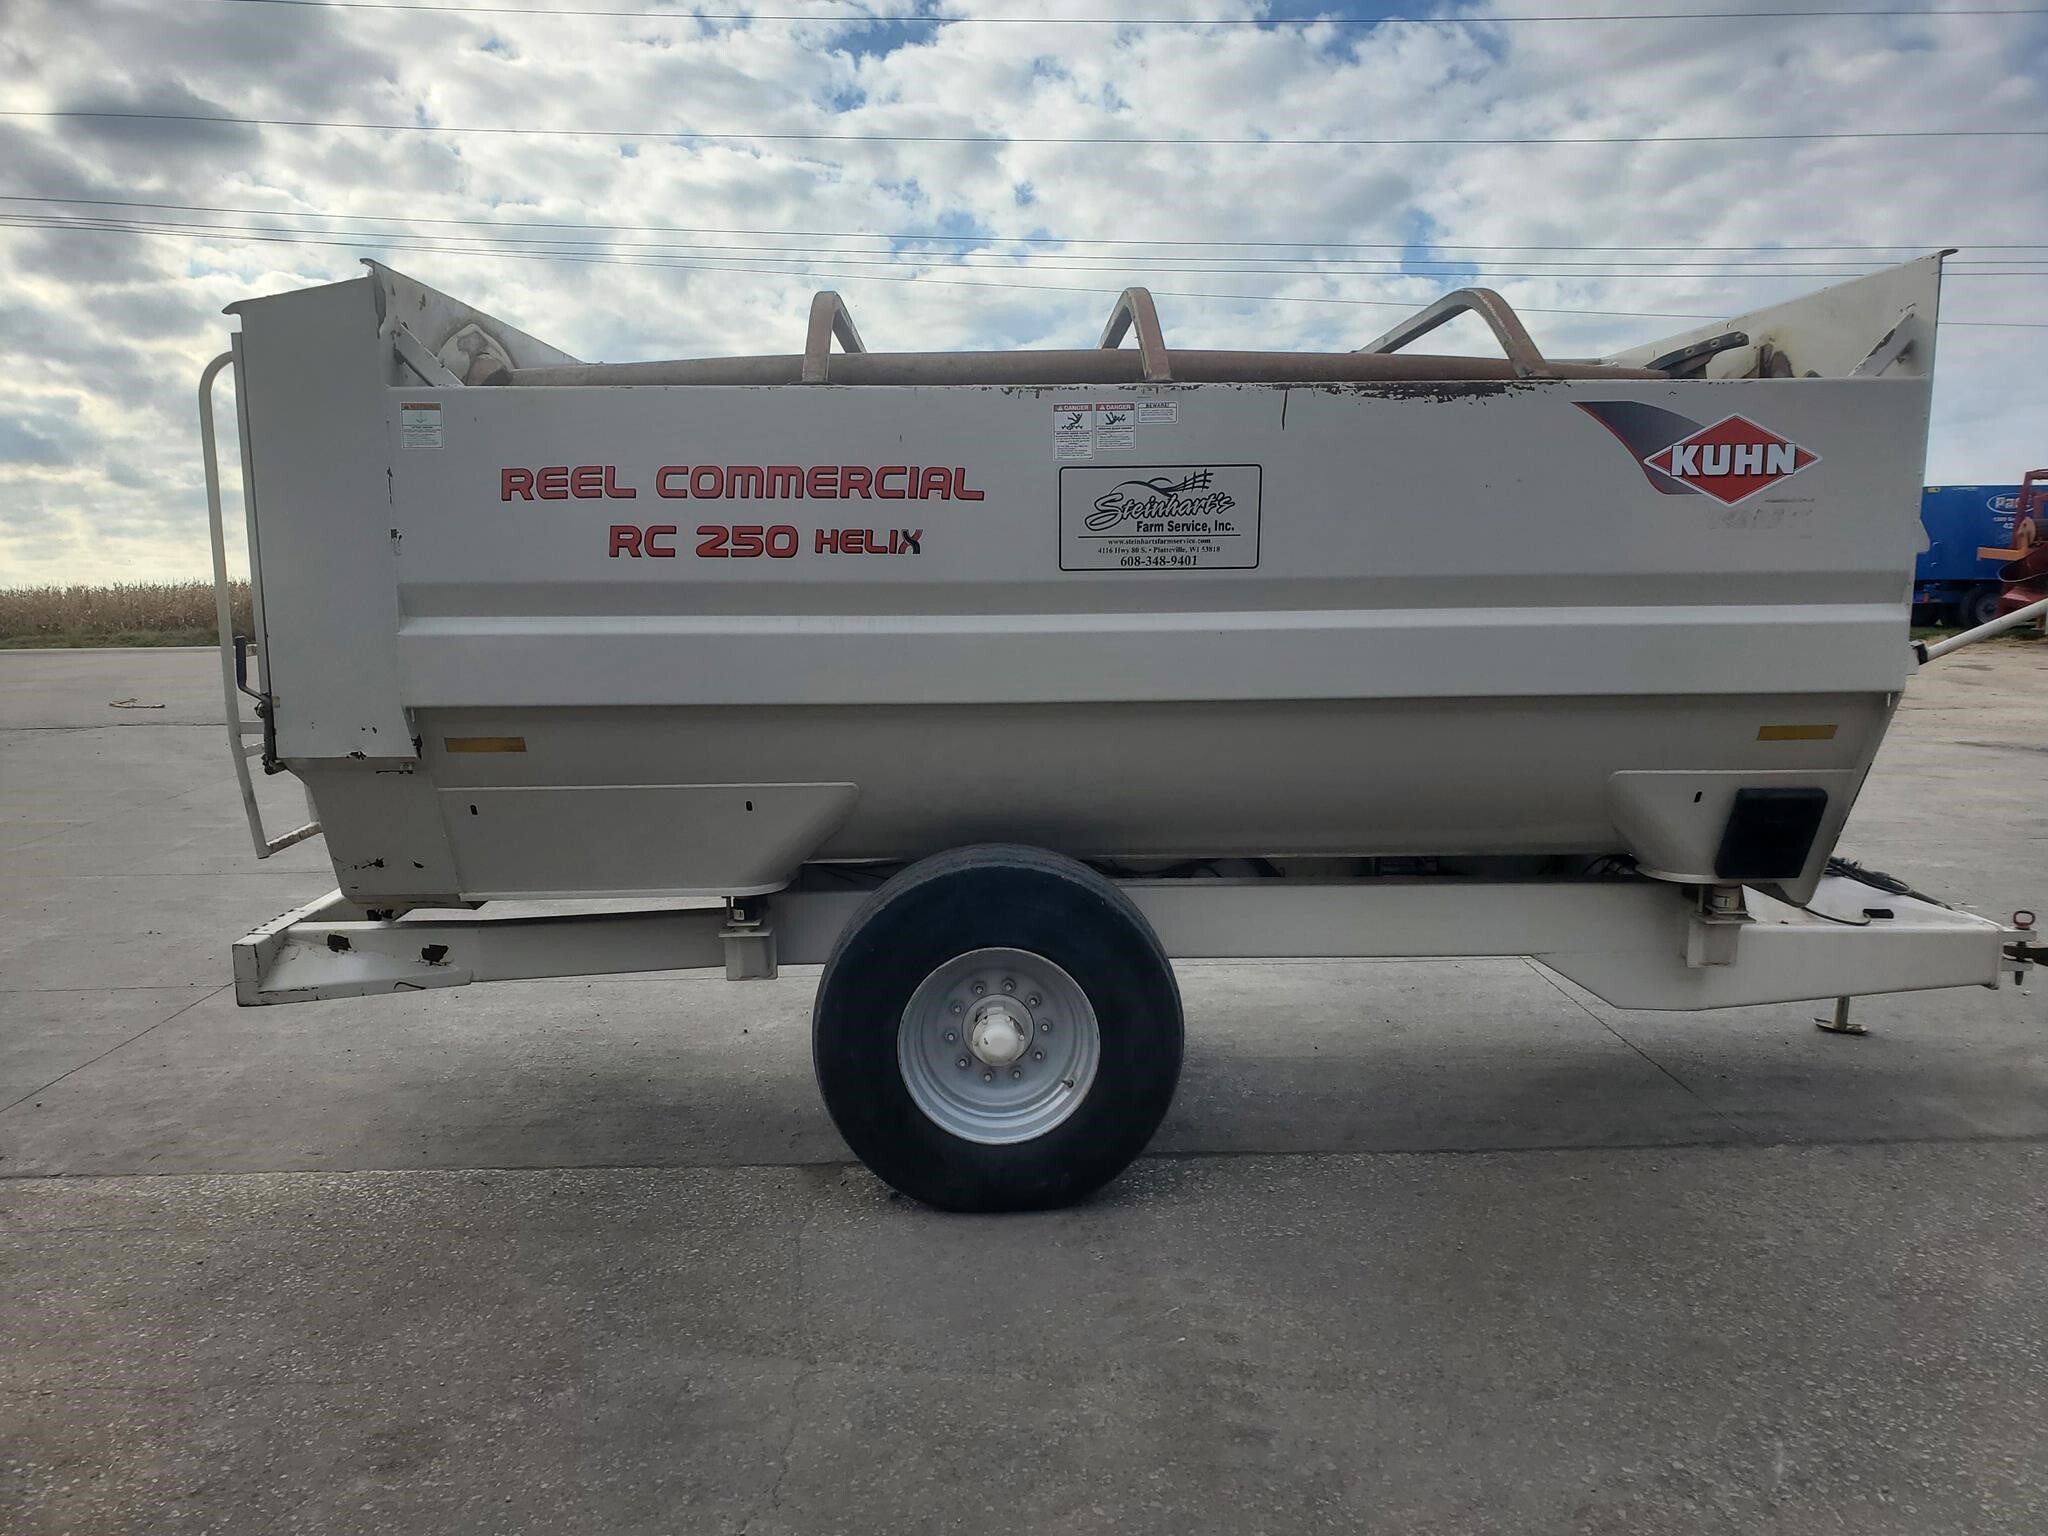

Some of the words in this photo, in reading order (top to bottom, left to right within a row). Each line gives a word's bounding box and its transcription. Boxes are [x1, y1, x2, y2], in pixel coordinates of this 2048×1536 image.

[1671, 443, 1796, 476] KUHN
[501, 466, 637, 501] REEL
[656, 466, 985, 501] COMMERCIAL
[1084, 492, 1236, 531] Steinhart's
[1136, 520, 1165, 533] Farm
[1167, 520, 1212, 534] Service,
[1214, 520, 1235, 532] Inc.
[609, 525, 677, 558] RC
[696, 525, 798, 558] 250
[815, 528, 923, 555] HELIX
[1120, 555, 1197, 567] 608-348-9401
